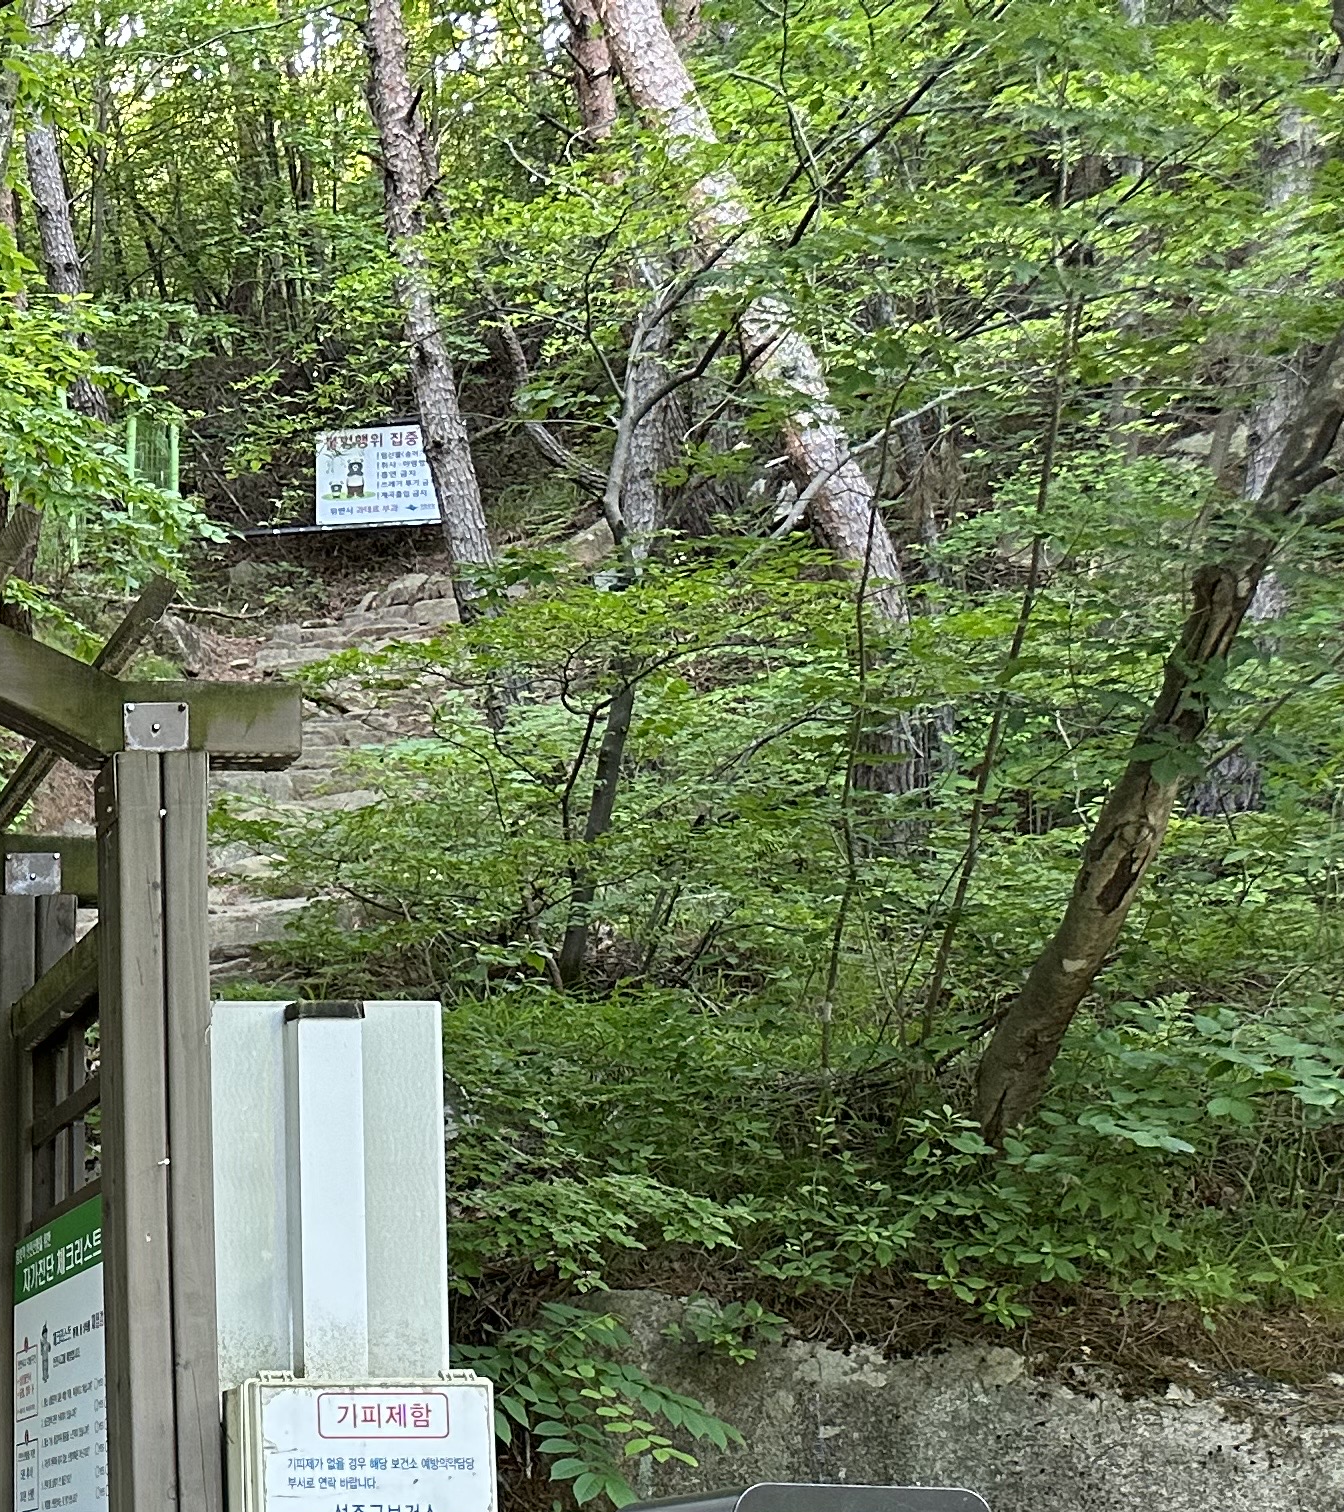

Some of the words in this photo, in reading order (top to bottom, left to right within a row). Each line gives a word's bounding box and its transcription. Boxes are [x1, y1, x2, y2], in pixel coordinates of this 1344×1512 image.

[390, 431, 419, 447] 집중
[22, 1252, 55, 1292] 자가진단
[56, 1228, 102, 1276] 체크리스트
[337, 1403, 432, 1428] 기피제함
[287, 1457, 323, 1471] 기피제가
[348, 1457, 366, 1471] 경우
[370, 1457, 387, 1471] 해당
[391, 1457, 418, 1471] 보건소
[288, 1477, 315, 1489] 부서로
[318, 1477, 336, 1489] 연락
